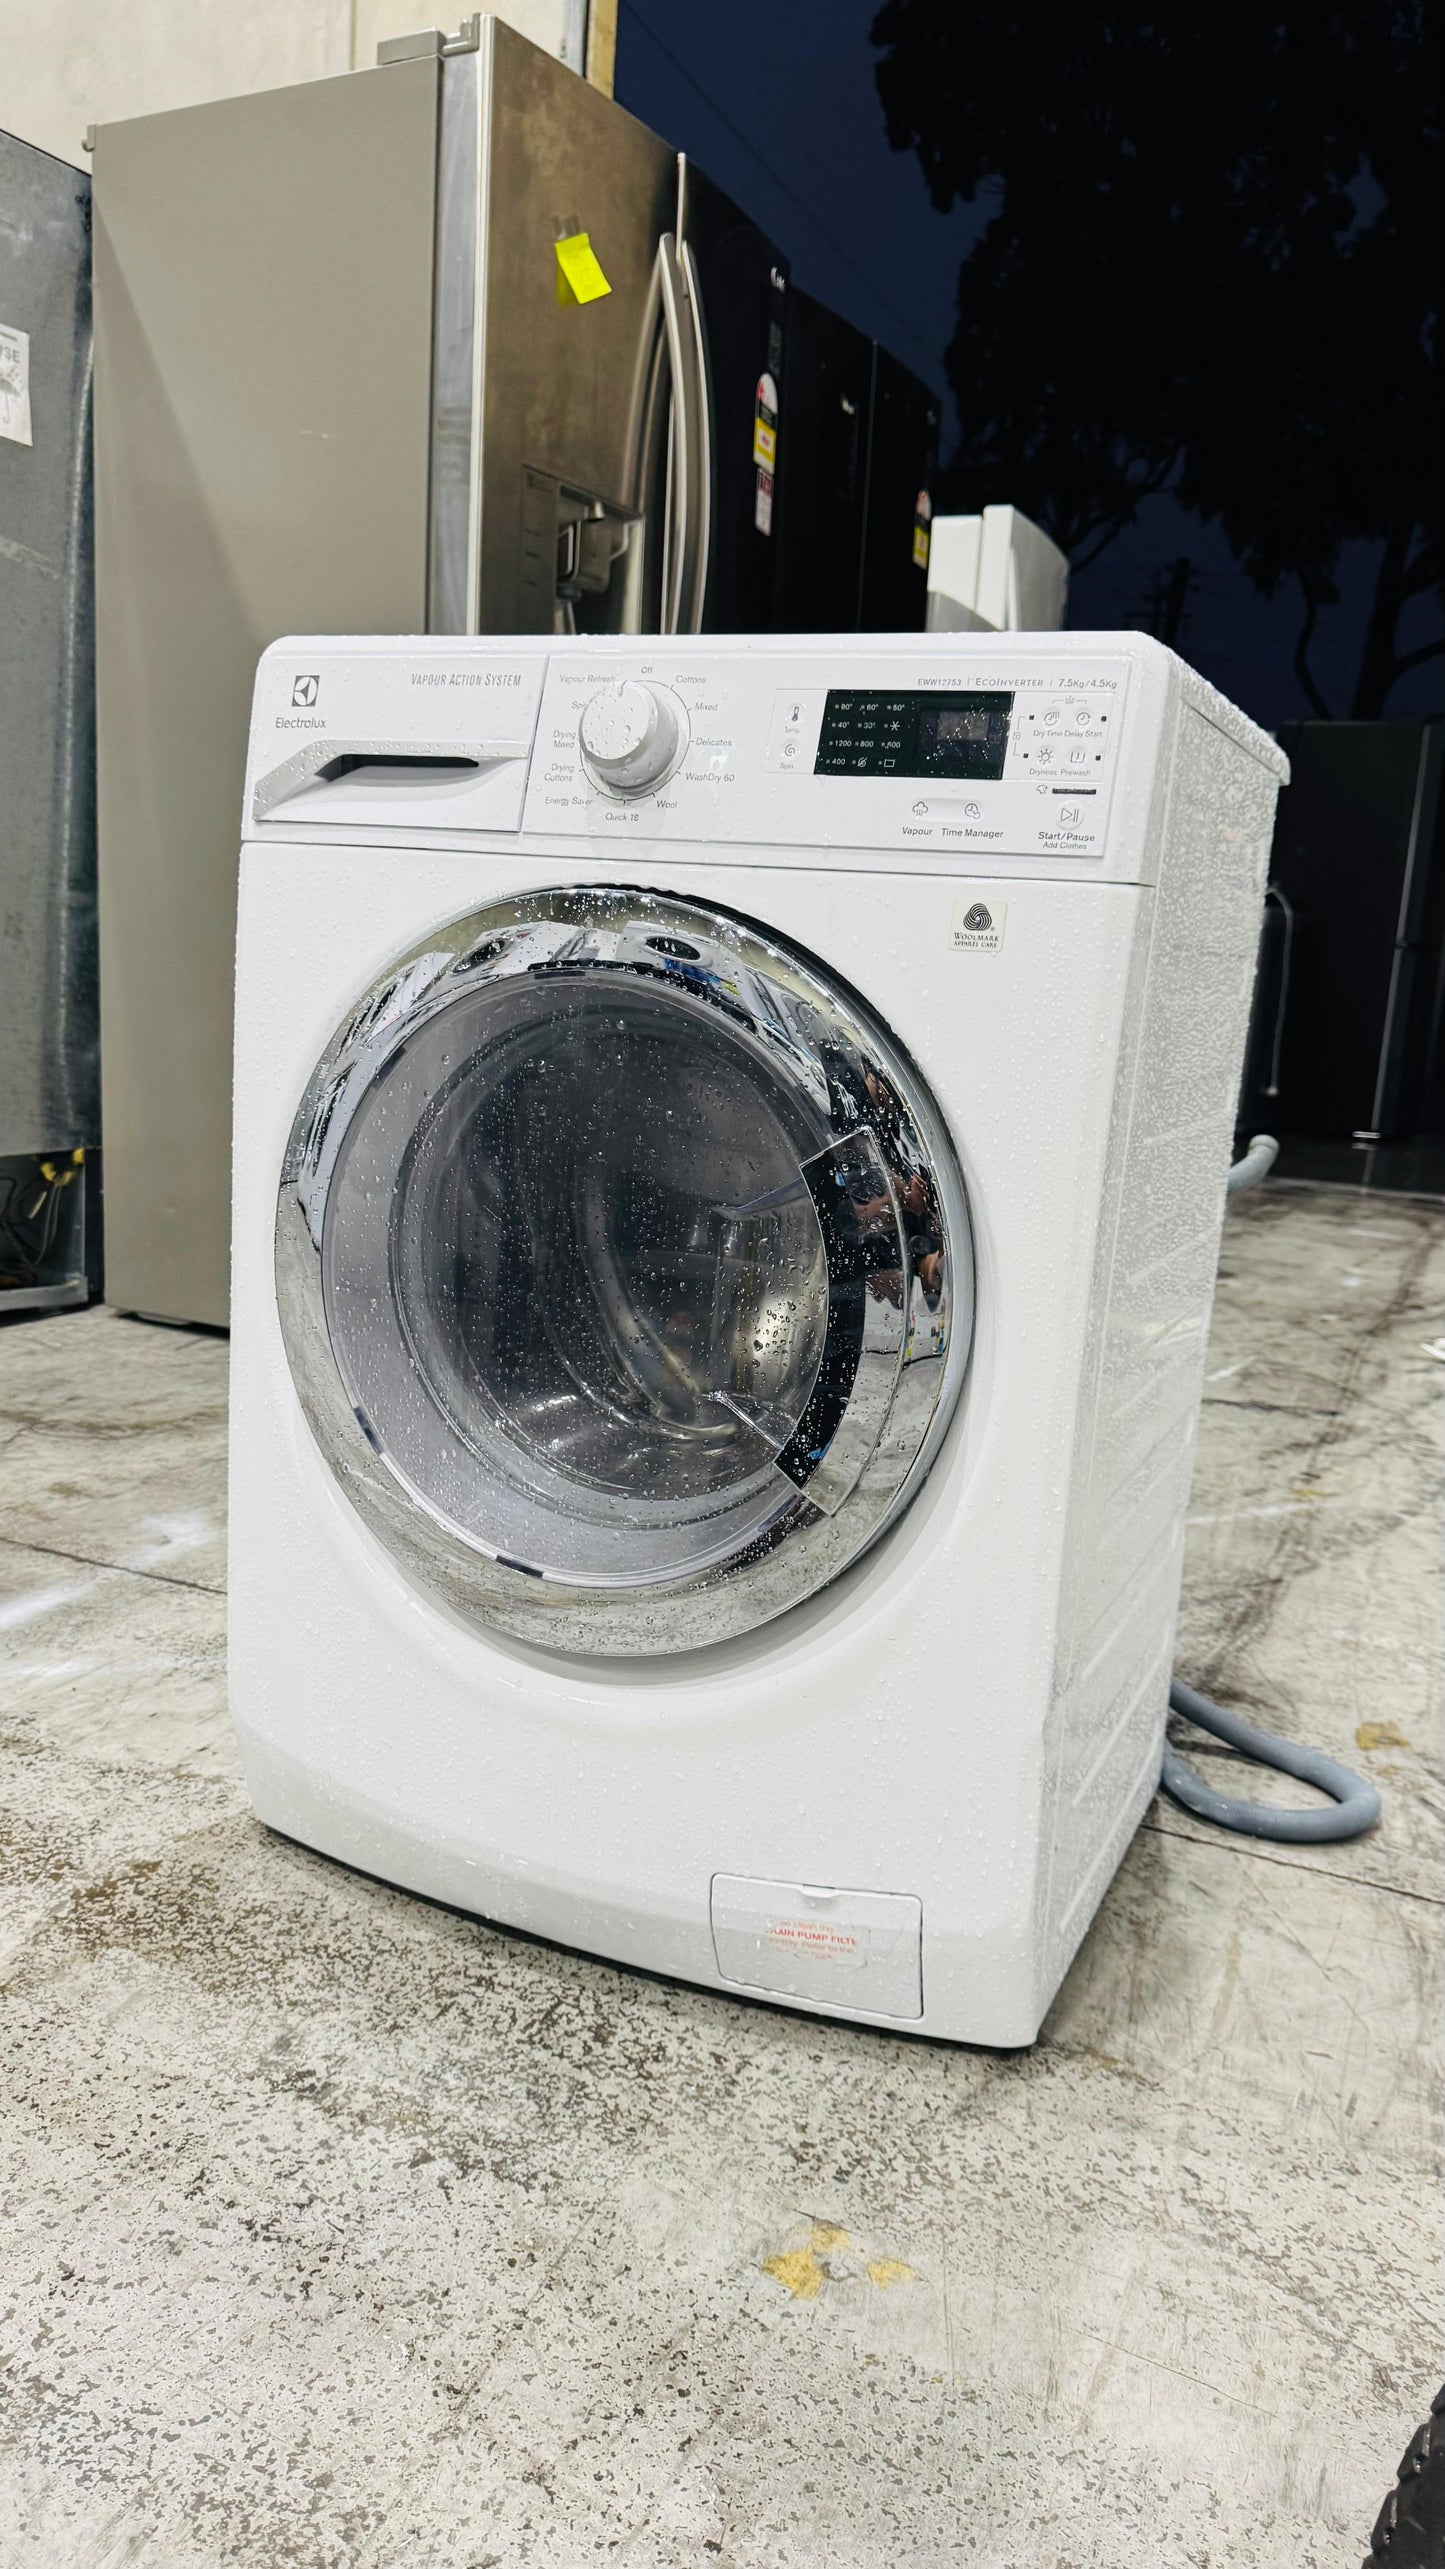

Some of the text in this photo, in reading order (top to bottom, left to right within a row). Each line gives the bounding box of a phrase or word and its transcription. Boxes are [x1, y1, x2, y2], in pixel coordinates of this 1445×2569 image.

[411, 673, 522, 687] VAPOUR ACTION SYSTEM
[675, 674, 707, 684] Cottons
[694, 702, 719, 712] Mixed
[275, 717, 327, 729] Electrolux
[553, 729, 577, 740] Drying
[1033, 729, 1045, 739] Dry
[1064, 730, 1103, 739] Delay Start
[696, 737, 732, 747] Delicates
[860, 740, 874, 748] 800
[831, 758, 846, 766] 400
[551, 763, 575, 774] Drying
[1029, 768, 1057, 777] Dryness
[544, 773, 573, 782] Cottons
[723, 773, 735, 782] 60
[545, 796, 593, 807] Energy Saver
[656, 800, 678, 809] Wool
[605, 811, 628, 821] Quick
[902, 826, 934, 837] Vapour
[941, 827, 1004, 840] Time Manager
[1038, 831, 1096, 842] Start/Pause
[1042, 841, 1088, 850] Add Clothes
[797, 1931, 828, 1941] PUMP
